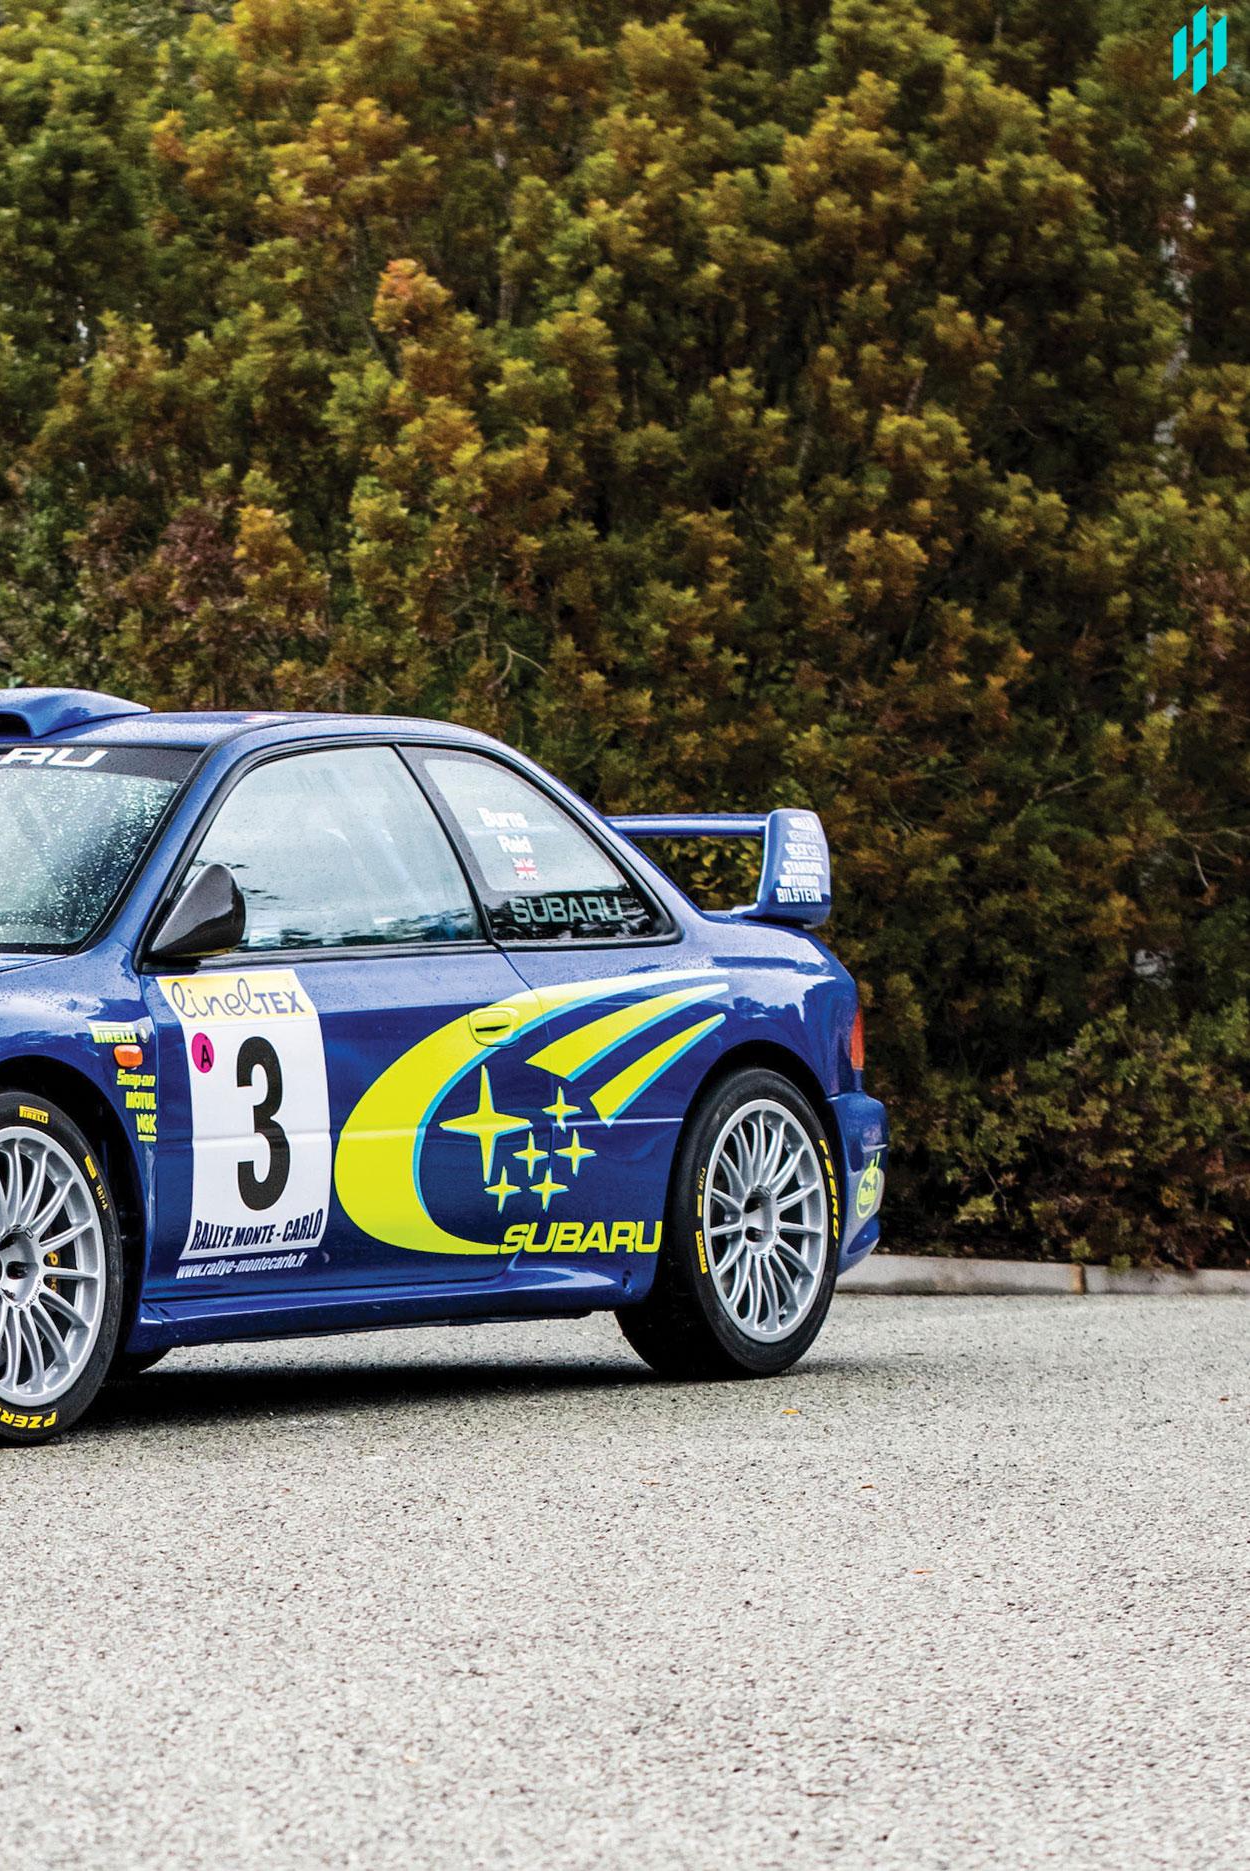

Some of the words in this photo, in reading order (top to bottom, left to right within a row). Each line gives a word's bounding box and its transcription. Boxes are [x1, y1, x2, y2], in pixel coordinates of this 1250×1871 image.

[776, 887, 822, 903] BILSTEIN
[509, 896, 624, 923] SUBARU
[201, 1044, 212, 1069] A
[126, 1091, 156, 1110] MOTUL
[136, 1113, 157, 1134] NGK
[236, 1036, 291, 1211] 3
[190, 1219, 233, 1250] RALLYE
[232, 1224, 276, 1247] MONTE
[282, 1208, 324, 1242] CARLO
[500, 1221, 663, 1254] SUBARU
[176, 1252, 308, 1280] www.rallye-montecarlo.fr
